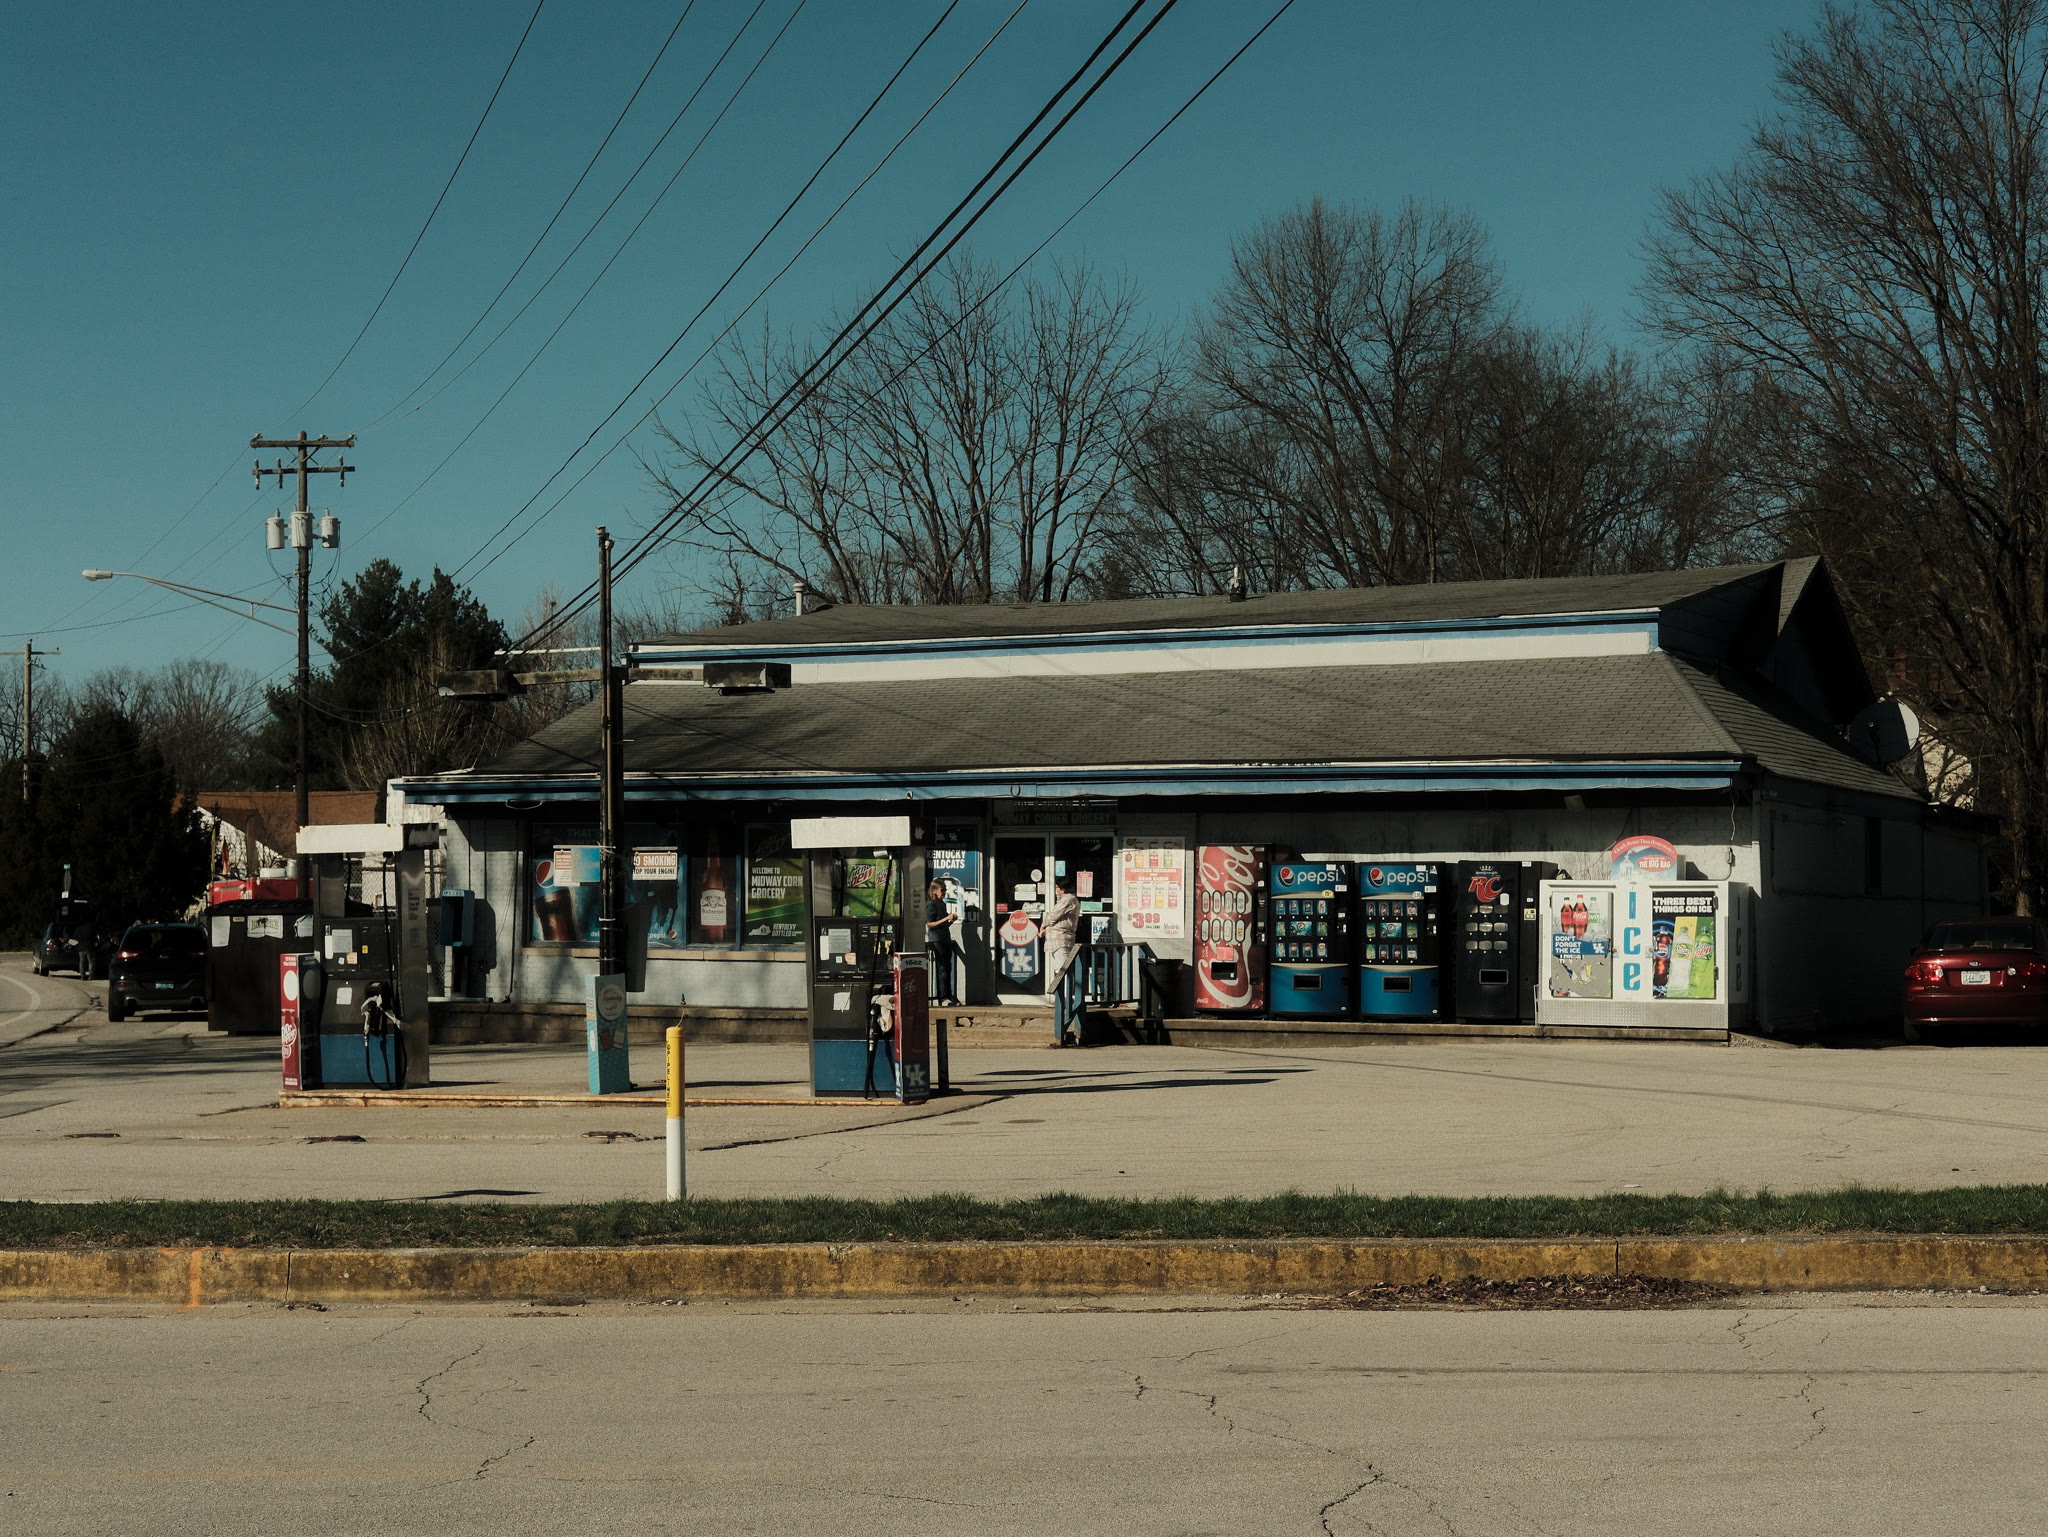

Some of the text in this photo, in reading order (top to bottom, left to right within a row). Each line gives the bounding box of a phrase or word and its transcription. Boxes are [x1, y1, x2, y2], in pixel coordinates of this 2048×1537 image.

[926, 849, 966, 859] KENTUCKY
[643, 855, 676, 866] SMOKING
[926, 859, 965, 869] WILDCATS
[1639, 860, 1672, 869] THE BIG BAG
[752, 867, 781, 875] WELCOME TO
[752, 875, 782, 887] MIDWAY
[1297, 869, 1339, 885] pepsi
[1387, 870, 1429, 886] pepsi
[752, 887, 786, 899] GROCERY
[1468, 876, 1504, 903] RC
[1652, 896, 1713, 906] THREE BEST
[1652, 905, 1713, 914] THINGS ON ICE
[1093, 926, 1111, 934] BAIT
[1006, 948, 1034, 973] UK
[904, 1063, 925, 1086] UK
